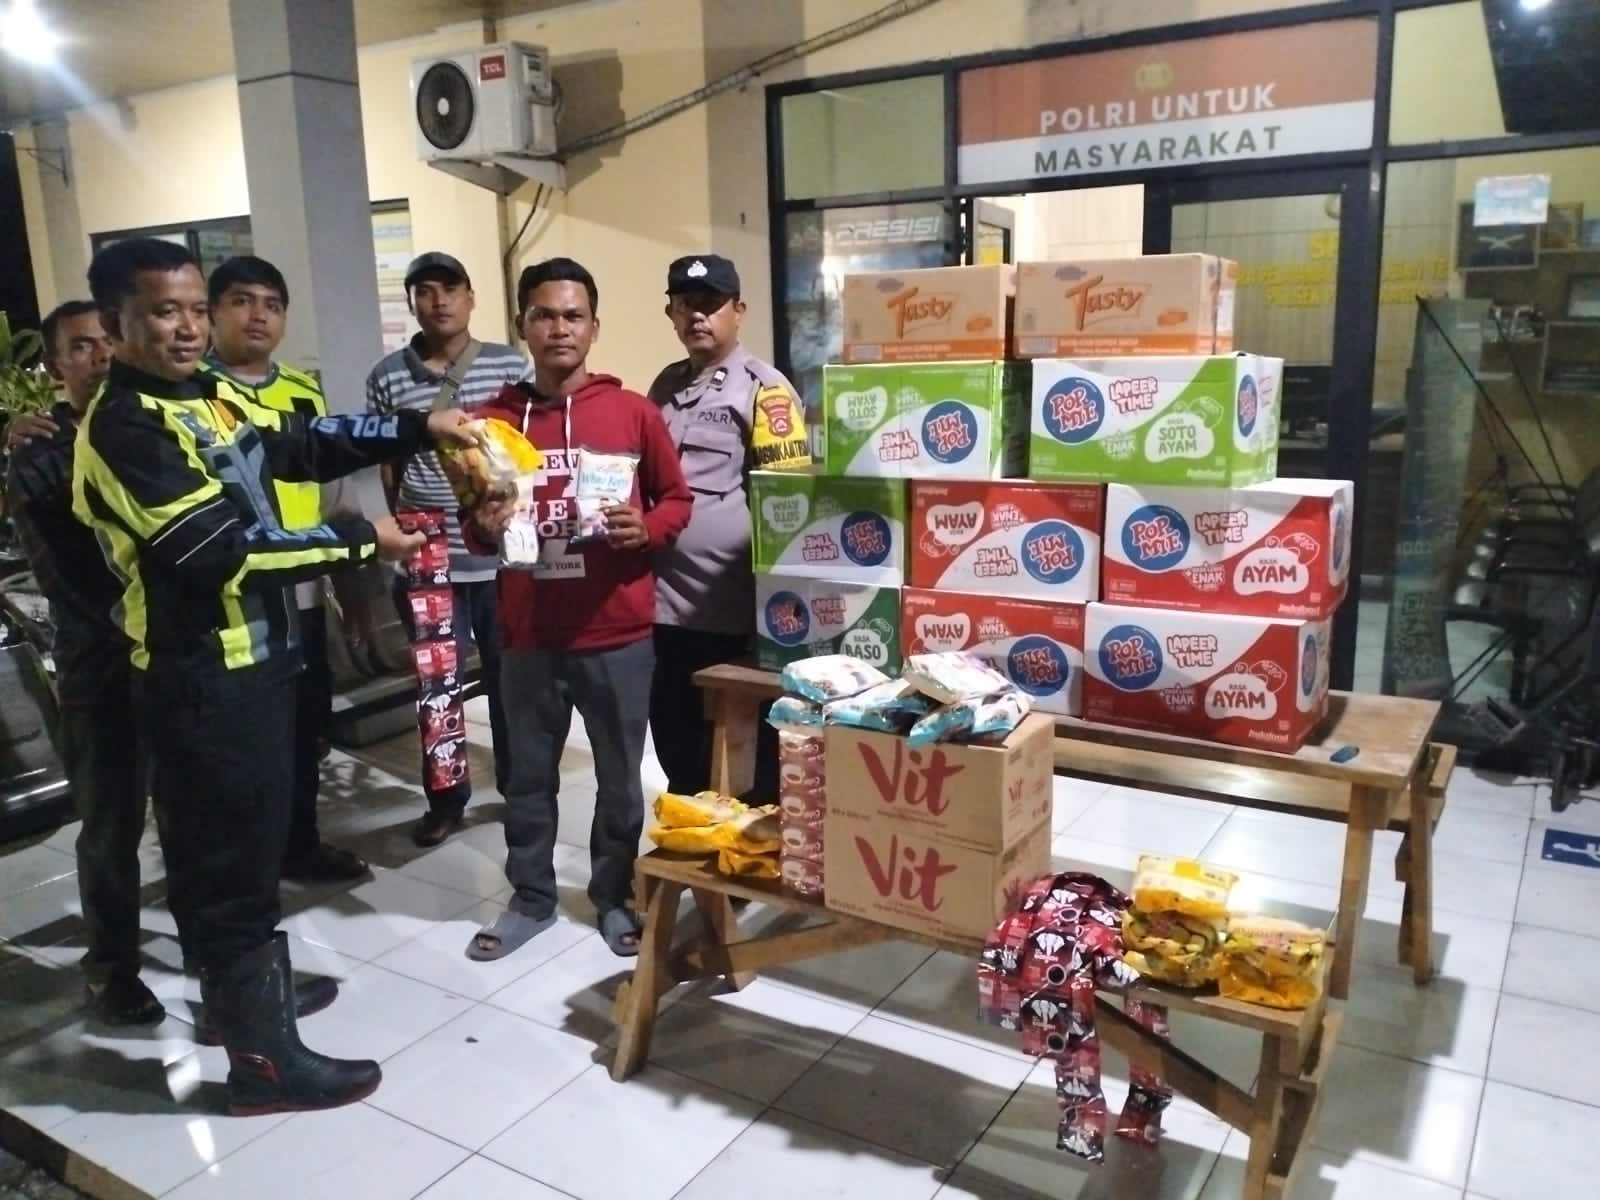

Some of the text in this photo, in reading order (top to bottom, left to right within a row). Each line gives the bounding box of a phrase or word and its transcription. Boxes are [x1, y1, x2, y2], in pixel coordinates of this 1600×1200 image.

[483, 63, 502, 73] TCL
[1040, 82, 1276, 134] POLRI UNTUK
[1035, 126, 1282, 174] MASYARAKAT
[887, 285, 953, 339] Tasty
[1065, 275, 1144, 331] Tasty
[1109, 377, 1158, 401] LAPEER
[1050, 387, 1088, 420] POP
[1116, 393, 1154, 414] TIME
[1059, 402, 1099, 433] MIE
[1159, 425, 1197, 440] SOTO
[1159, 439, 1198, 455] AYAM
[935, 512, 977, 530] AYAM
[1130, 515, 1170, 545] POP
[1194, 510, 1249, 533] LAPEER
[1140, 529, 1184, 560] MIE
[1201, 528, 1244, 545] TIME
[555, 560, 582, 570] YORK
[976, 546, 1012, 564] TIME
[1039, 545, 1076, 575] POP
[974, 559, 1018, 577] LAPEER
[1192, 571, 1223, 584] ENAK
[1241, 565, 1297, 583] AYAM
[923, 623, 964, 639] AYAM
[845, 644, 881, 660] BASO
[1106, 635, 1144, 664] POP
[1167, 635, 1218, 654] LAPEER
[1116, 650, 1157, 678] MIE
[1174, 651, 1214, 668] TIME
[1212, 690, 1266, 708] AYAM
[858, 738, 966, 816] Vit
[855, 834, 958, 912] Vit
